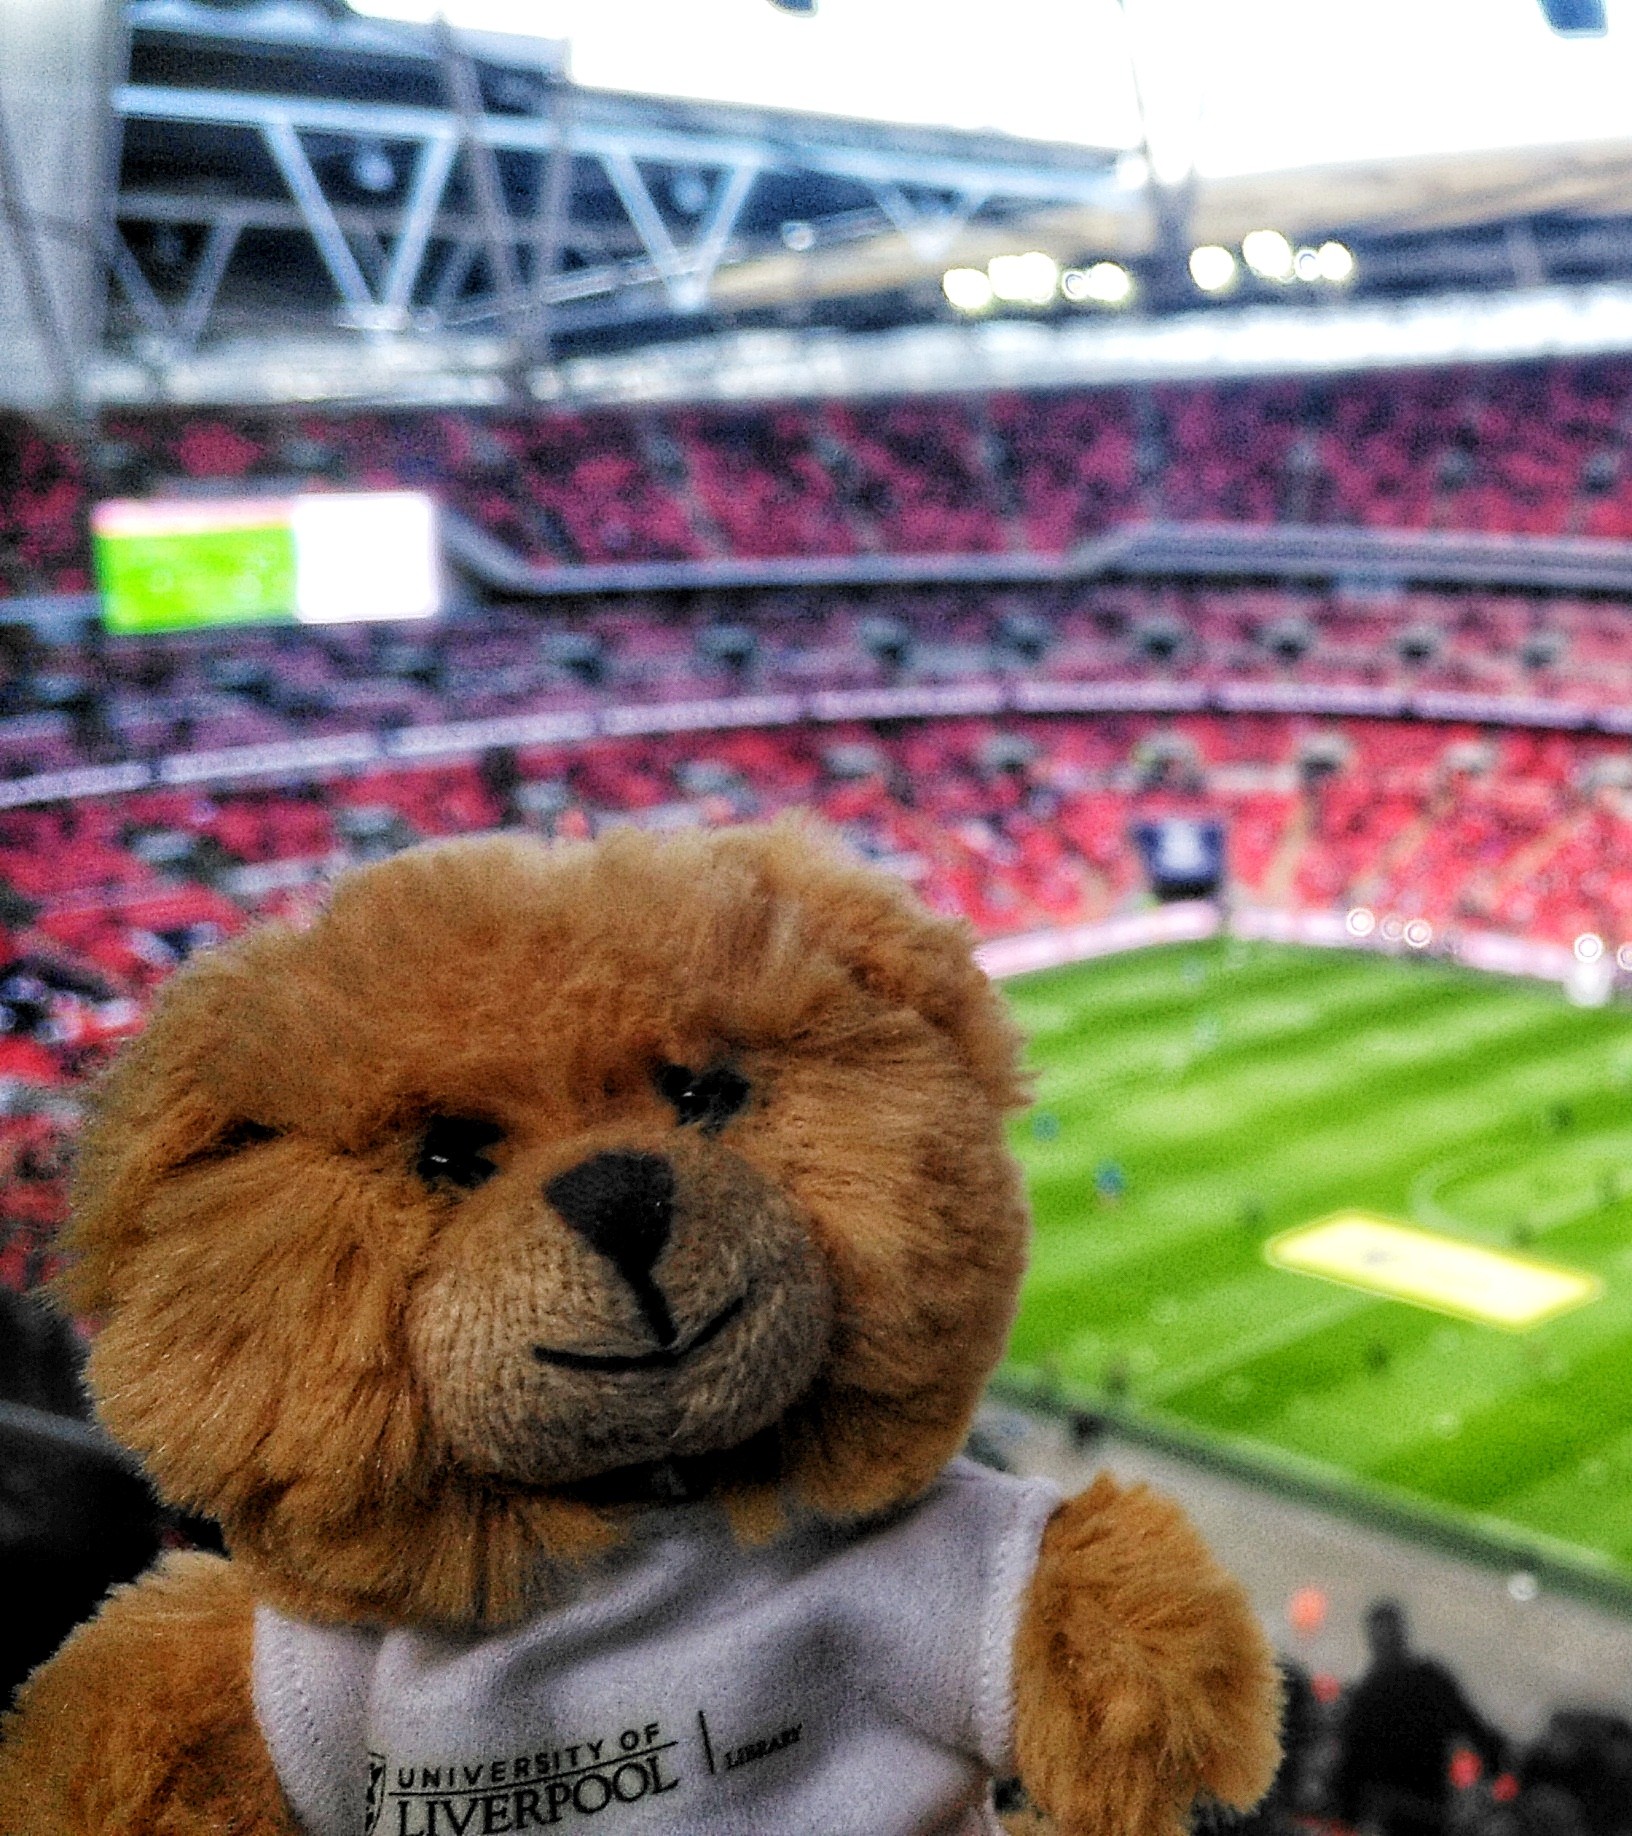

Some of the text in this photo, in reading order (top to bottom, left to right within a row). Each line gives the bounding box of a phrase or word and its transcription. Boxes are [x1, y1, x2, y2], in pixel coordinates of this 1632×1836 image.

[398, 1722, 660, 1788] UNIVERSITY OF
[399, 1755, 680, 1836] LIVERPOOL
